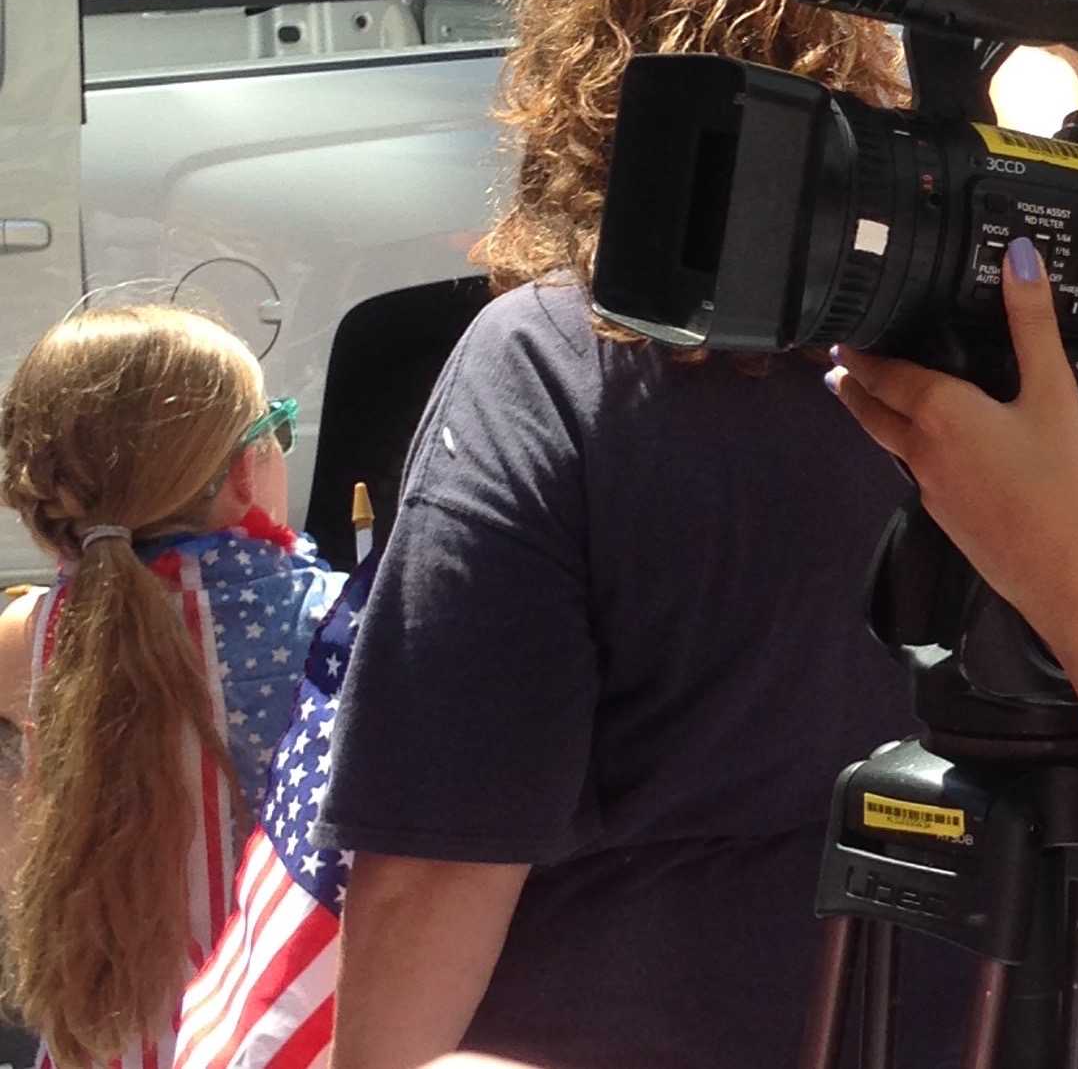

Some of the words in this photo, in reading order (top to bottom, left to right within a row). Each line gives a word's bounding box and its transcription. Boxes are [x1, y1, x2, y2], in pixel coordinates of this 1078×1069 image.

[986, 157, 1026, 174] 3CCD
[1017, 201, 1044, 215] FOCUS
[1046, 207, 1072, 219] ASSIST
[1039, 216, 1064, 230] FILTER
[982, 224, 1010, 237] FOCUS
[976, 274, 1000, 285] AUTO
